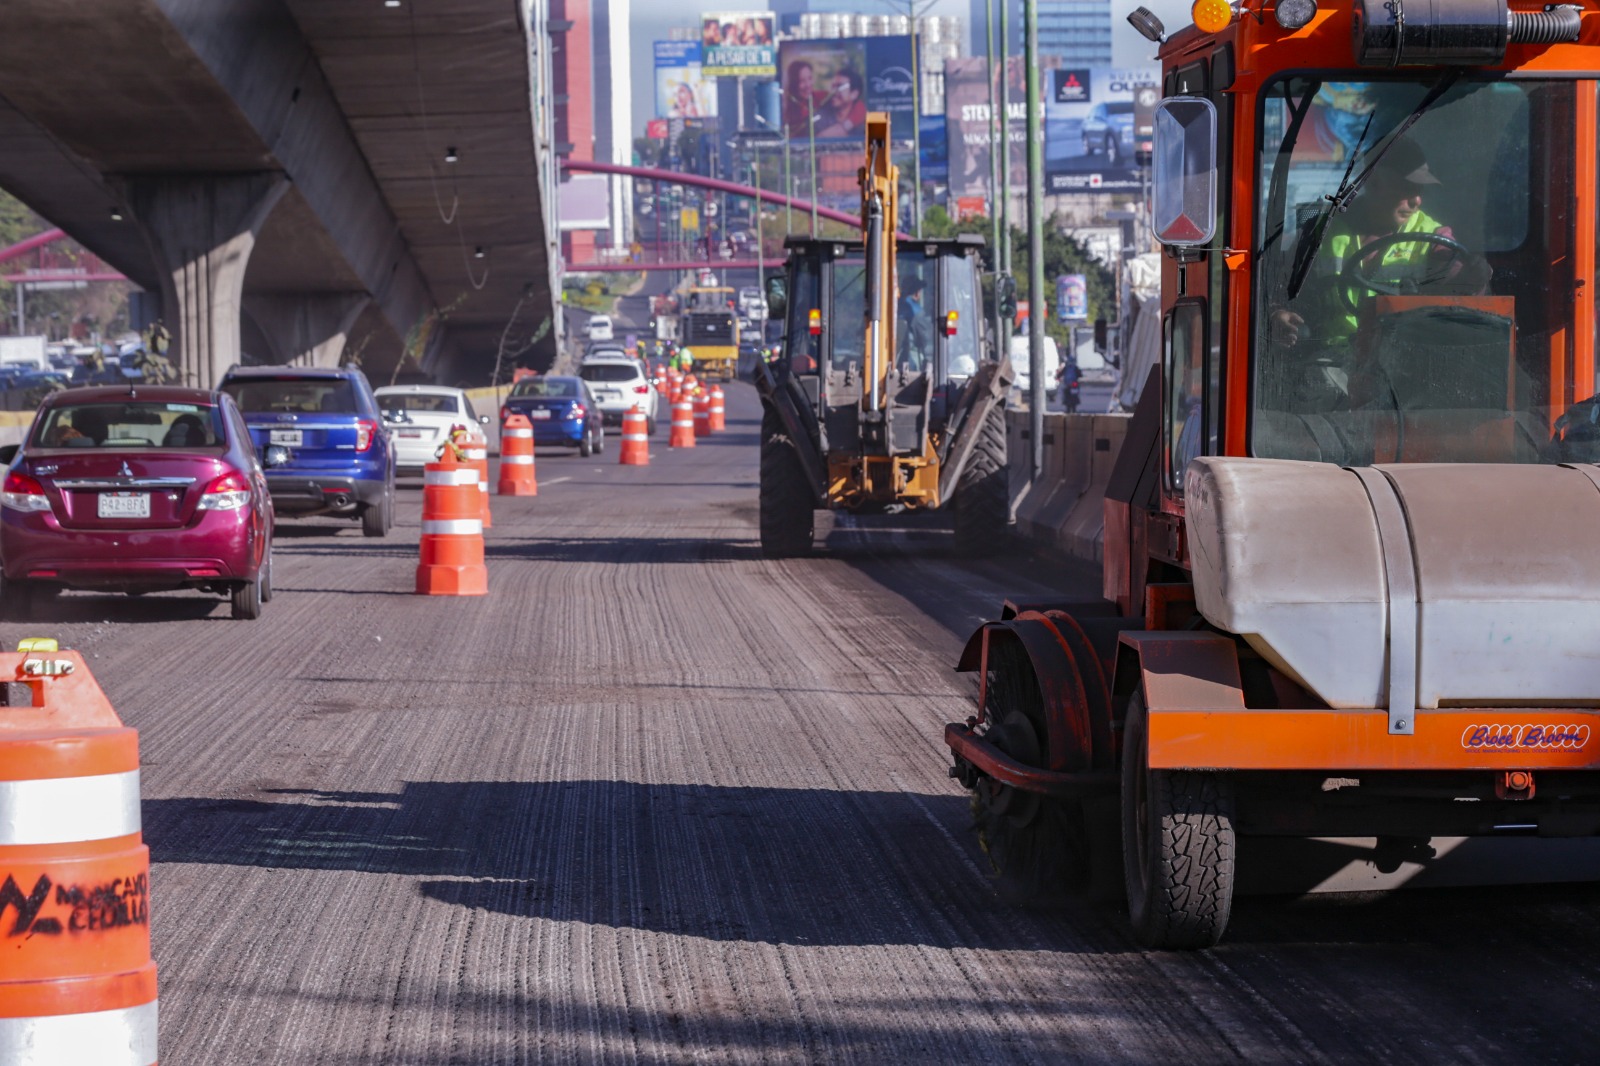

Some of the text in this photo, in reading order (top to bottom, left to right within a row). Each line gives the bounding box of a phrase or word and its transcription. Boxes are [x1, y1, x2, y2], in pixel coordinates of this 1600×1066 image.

[1110, 72, 1151, 80] NUEVA
[1468, 727, 1583, 746] Broce Broom
